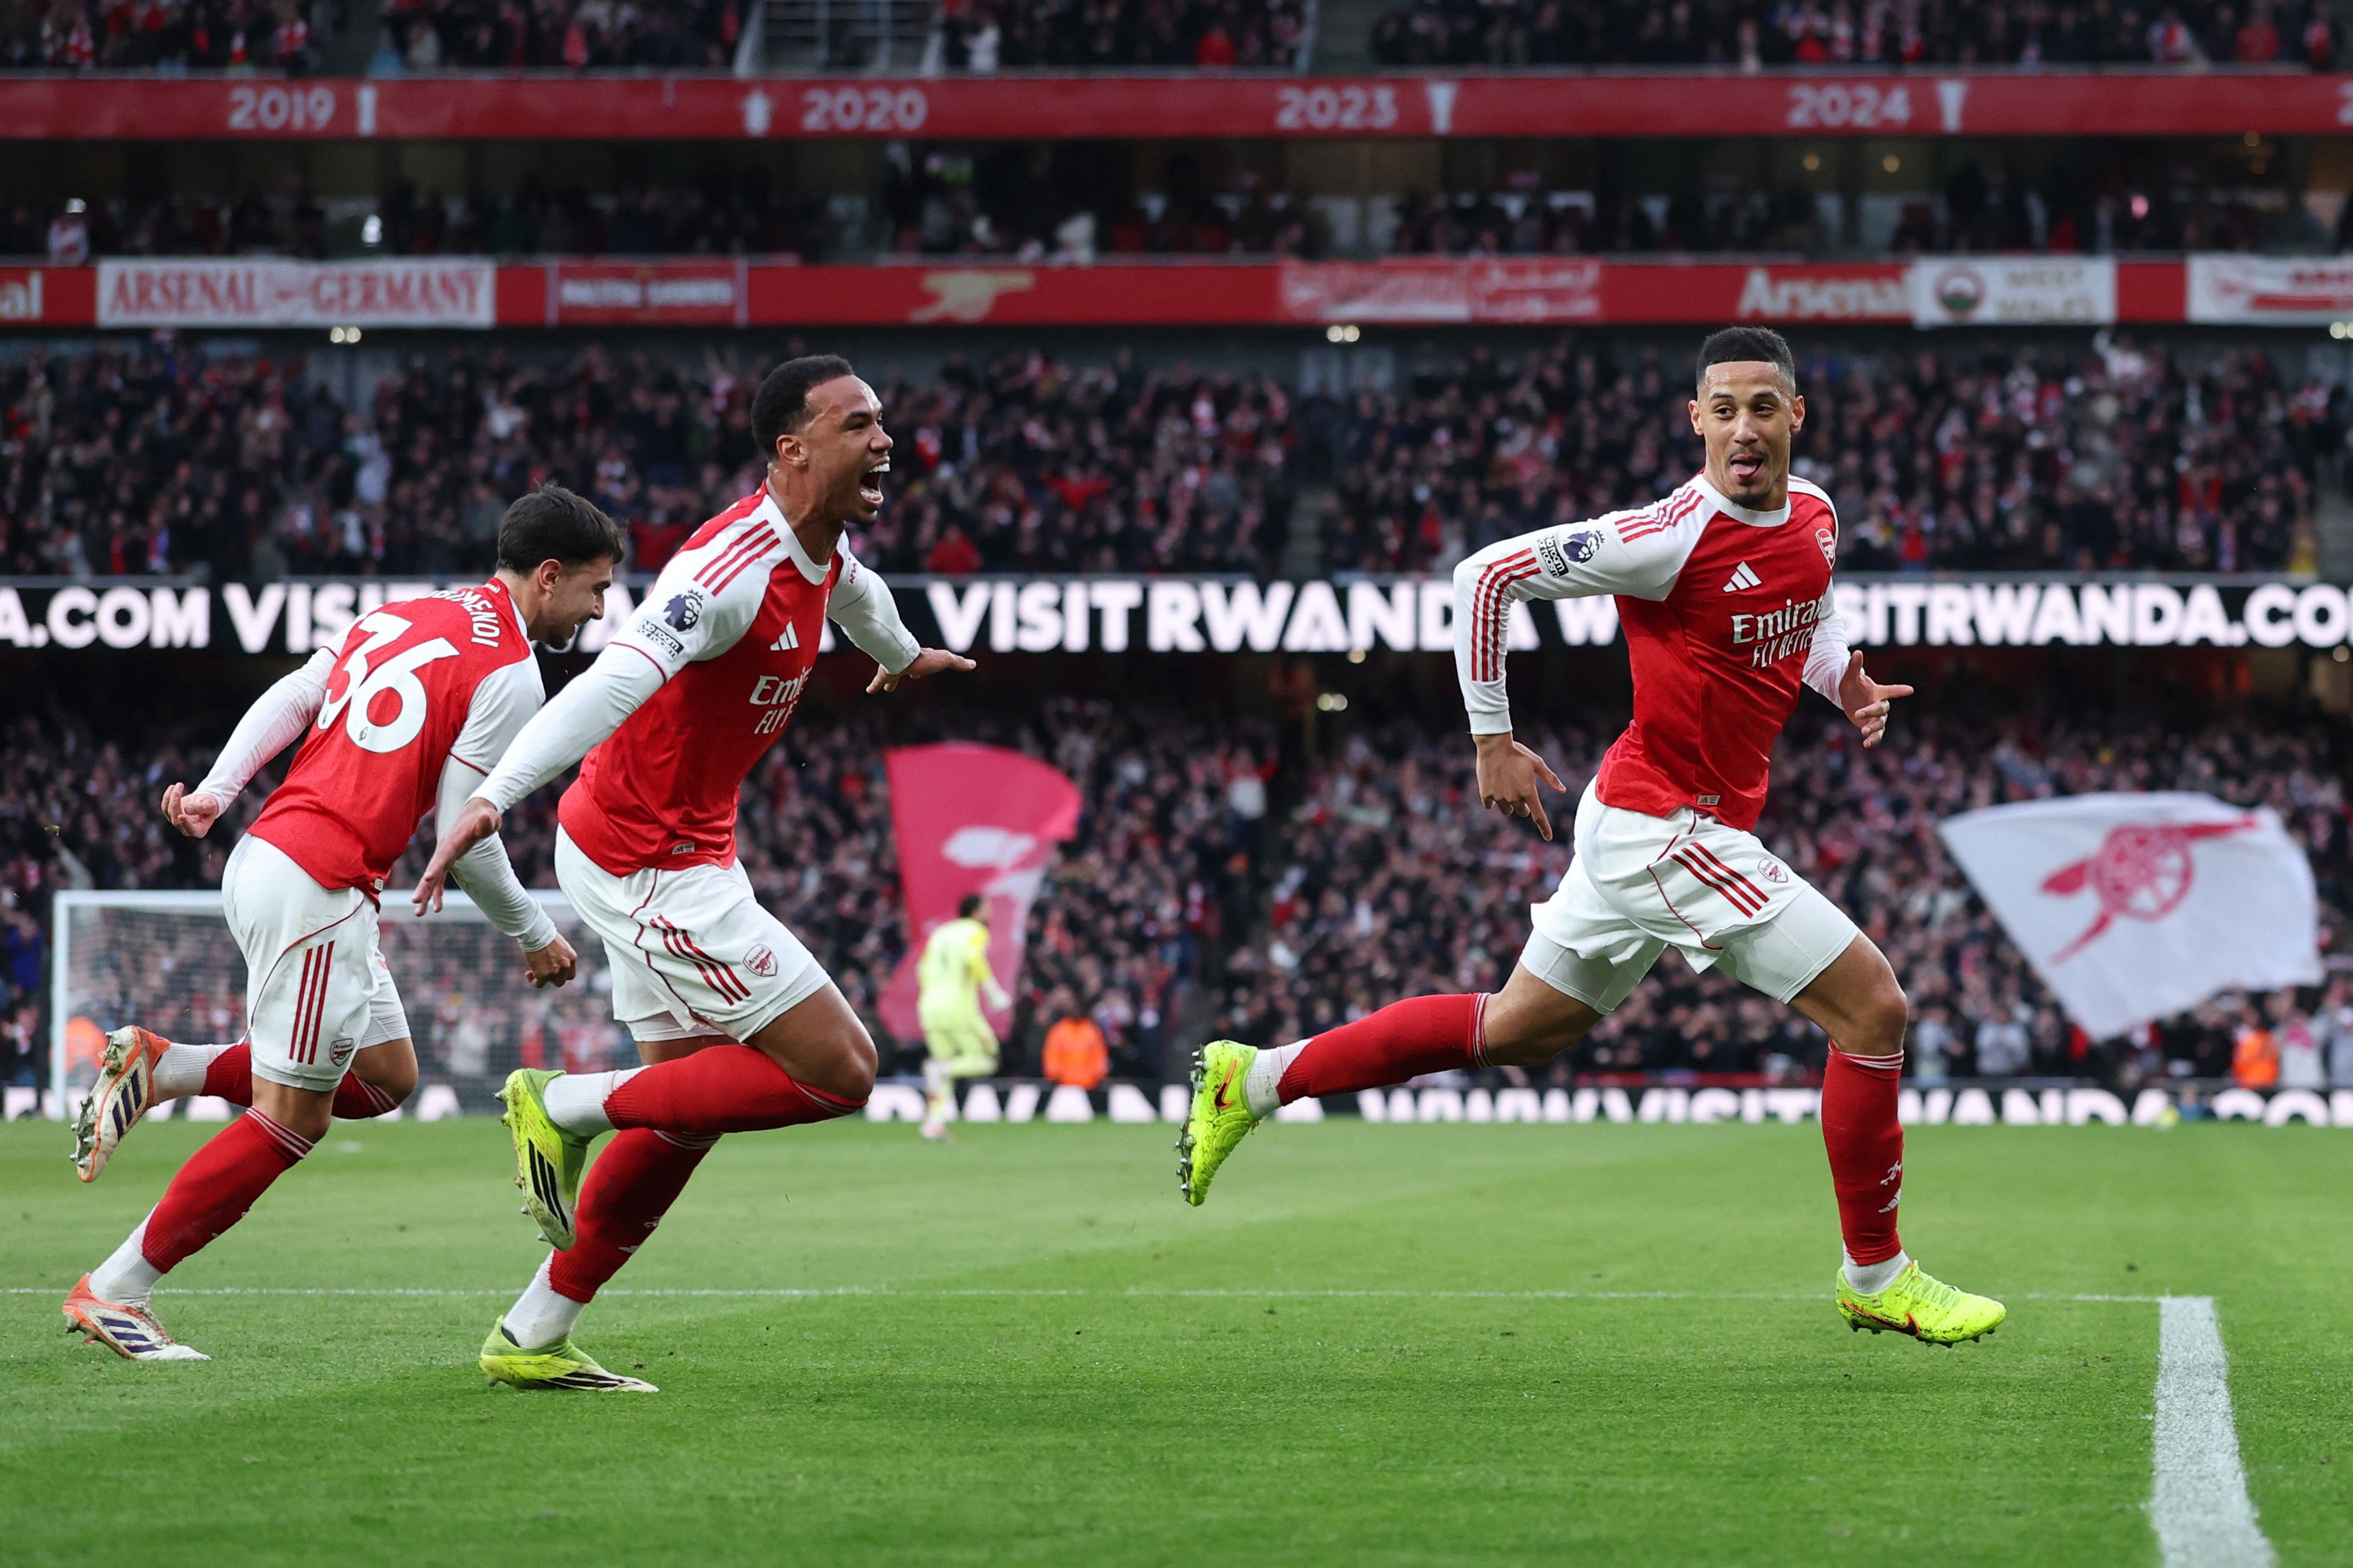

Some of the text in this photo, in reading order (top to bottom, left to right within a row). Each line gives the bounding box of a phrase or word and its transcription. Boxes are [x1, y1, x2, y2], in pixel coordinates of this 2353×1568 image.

[229, 87, 334, 129] 2019
[801, 87, 928, 130] 2020
[1276, 86, 1398, 128] 2023
[1787, 84, 1911, 127] 2024
[110, 266, 484, 318] ARSENAL GERMANY
[1737, 268, 1911, 318] Arsena
[1547, 547, 1565, 572] room
[654, 628, 679, 651] room
[1731, 598, 1825, 644] Emira
[1751, 638, 1779, 667] FLY
[318, 612, 461, 753] 36
[754, 707, 786, 734] FLY
